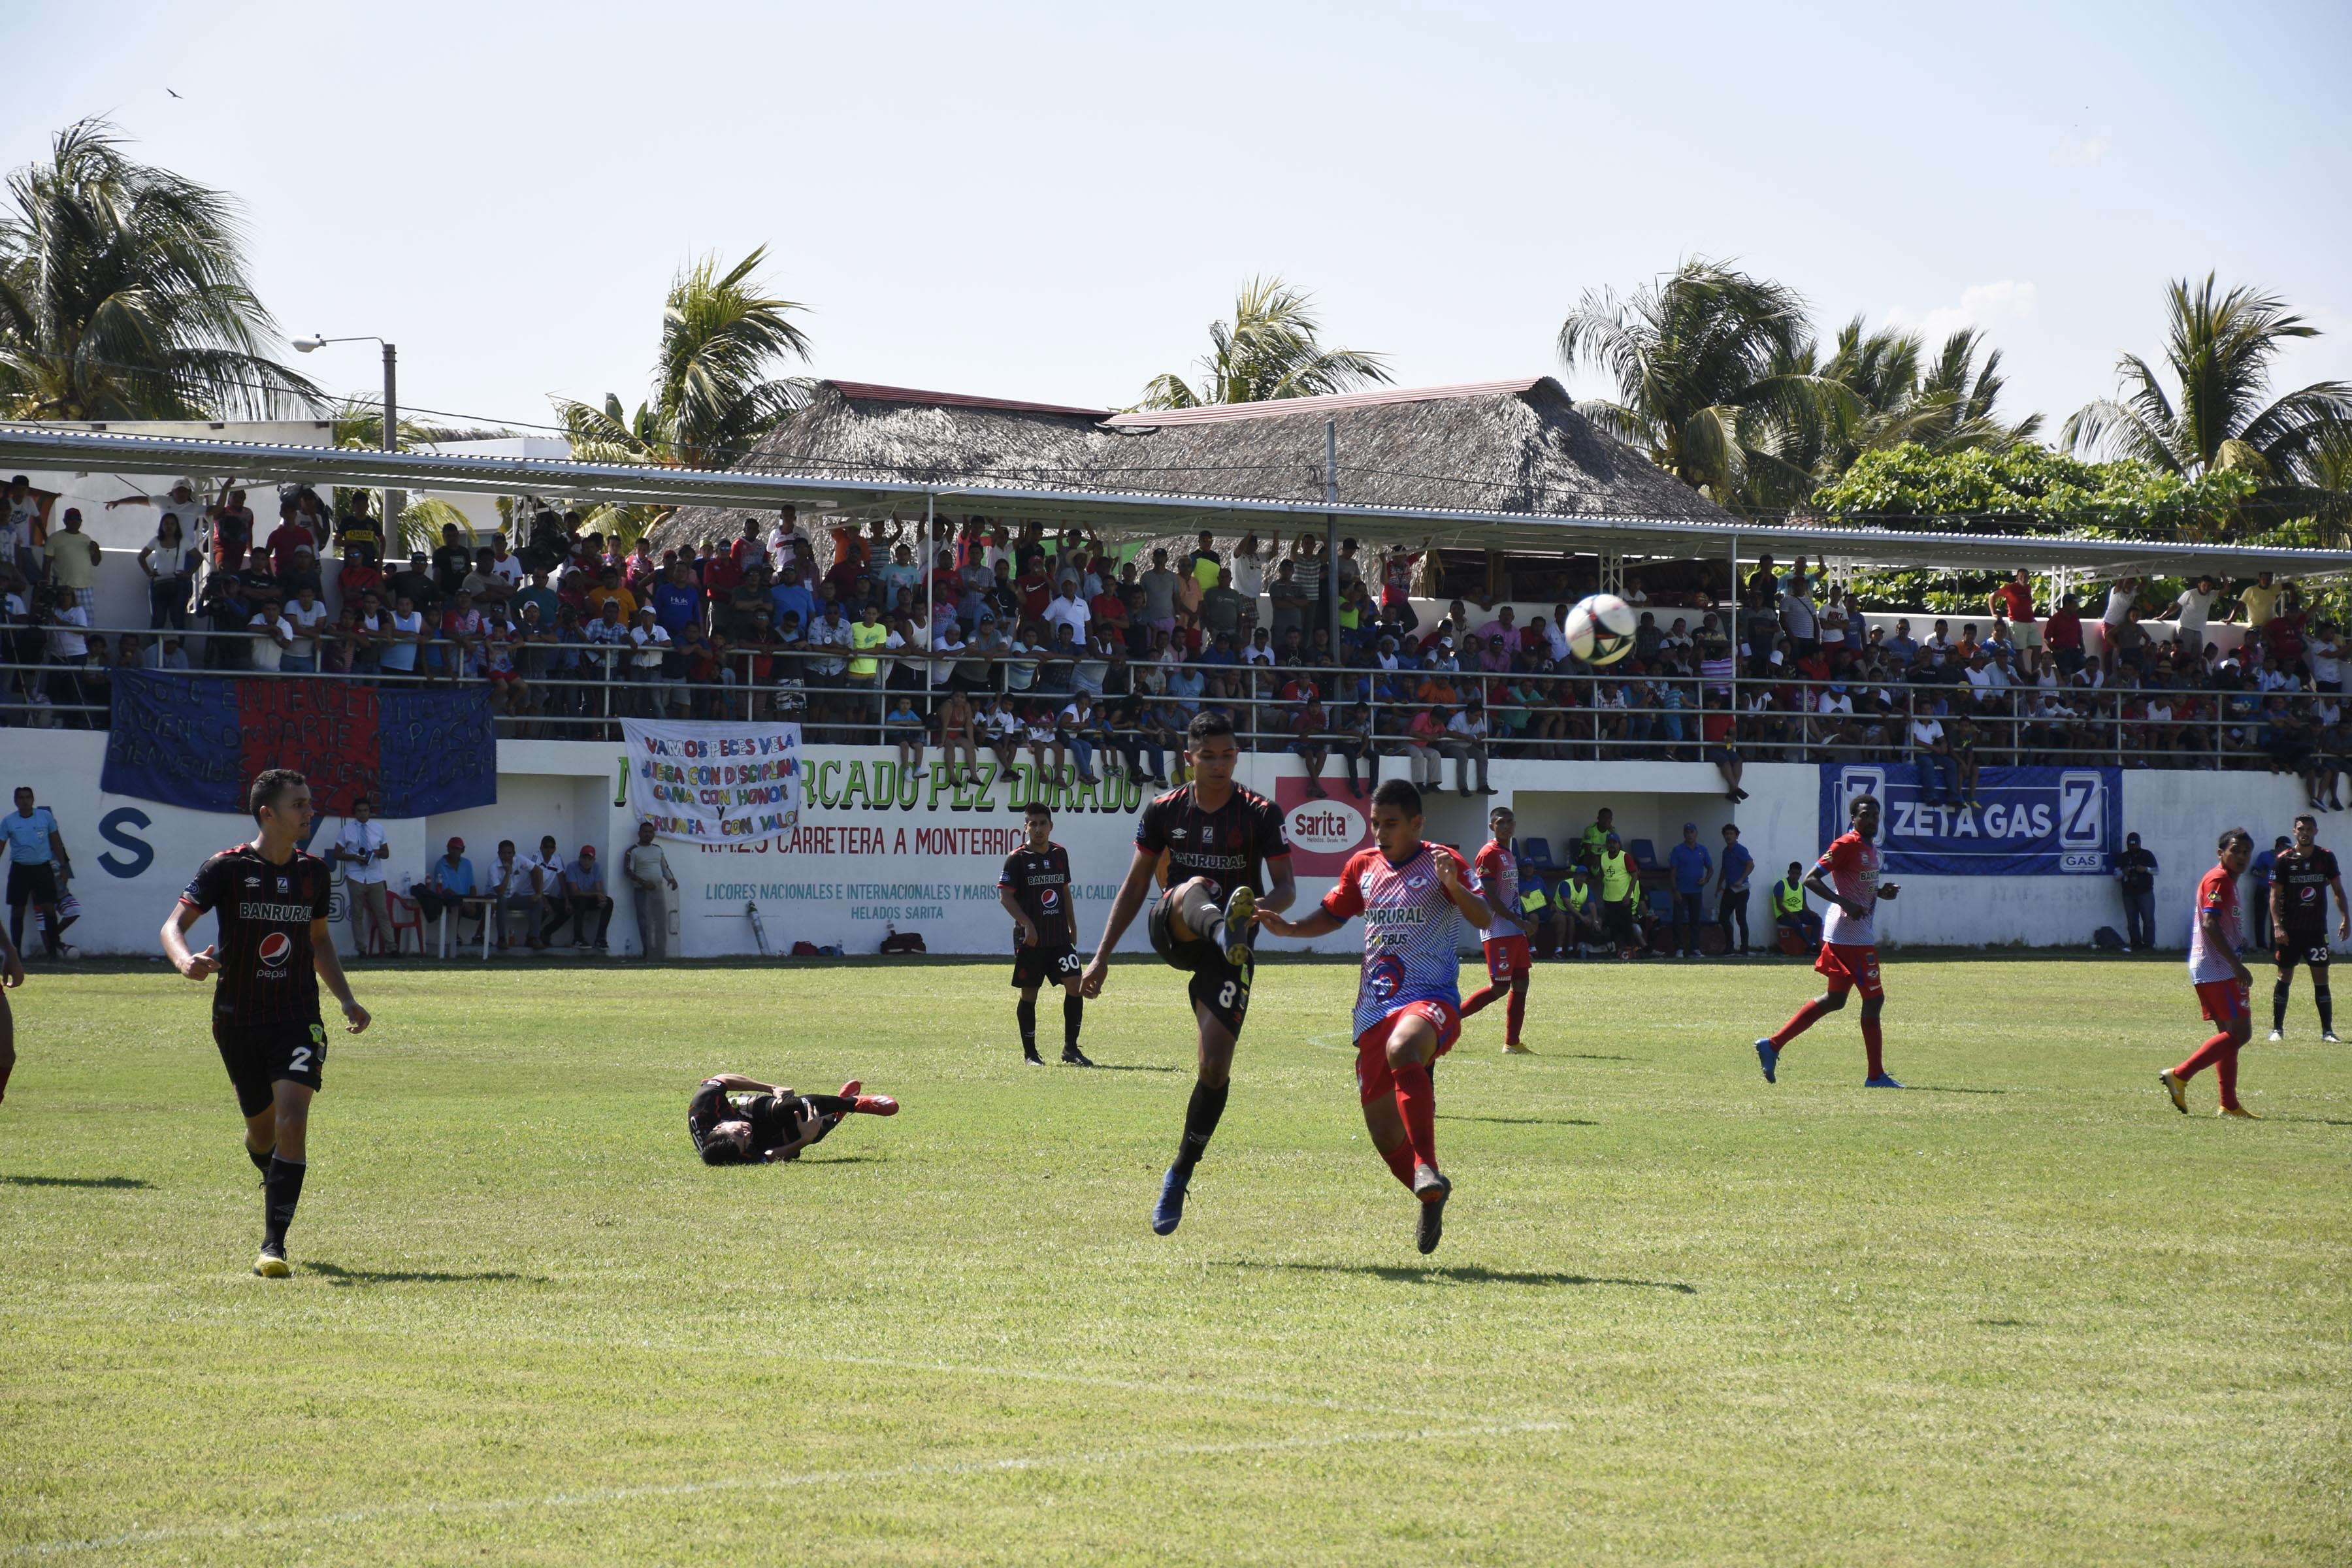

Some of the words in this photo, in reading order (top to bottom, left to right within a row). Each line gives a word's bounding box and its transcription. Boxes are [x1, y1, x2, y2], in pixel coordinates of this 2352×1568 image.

[644, 737, 708, 758] VAMOS
[710, 739, 756, 757] PECES
[759, 734, 794, 755] VELA
[688, 766, 720, 785] CON
[725, 757, 799, 785] DISCIPLINA
[653, 785, 694, 804] GANA
[700, 789, 731, 805] CON
[737, 785, 788, 806] HONOR
[927, 761, 997, 813] PEZ
[1007, 762, 1142, 815] DORADO
[644, 813, 706, 835] TRIUNFA
[721, 817, 753, 835] CON
[759, 810, 798, 831] VALO
[716, 806, 725, 820] Y
[1295, 810, 1346, 836] Sarita
[1893, 801, 1979, 838] ZETA
[1984, 803, 2053, 838] GAS
[777, 826, 885, 854] CARRETERA
[893, 828, 907, 855] A
[916, 828, 1026, 855] MONTERRIC
[2066, 855, 2096, 866] GAS
[706, 883, 757, 900] LICORES
[760, 883, 834, 900] NACIONALES
[836, 884, 843, 900] E
[847, 884, 951, 900] INTERNACIONALES
[955, 885, 961, 900] Y
[239, 902, 314, 922] BANRURAL
[851, 906, 900, 920] HELADOS
[906, 906, 943, 919] SARITA
[1058, 953, 1080, 972] 30
[2310, 947, 2328, 961] 23
[256, 968, 287, 980] pepsi
[1218, 981, 1237, 1009] 8
[288, 1046, 312, 1072] 2
